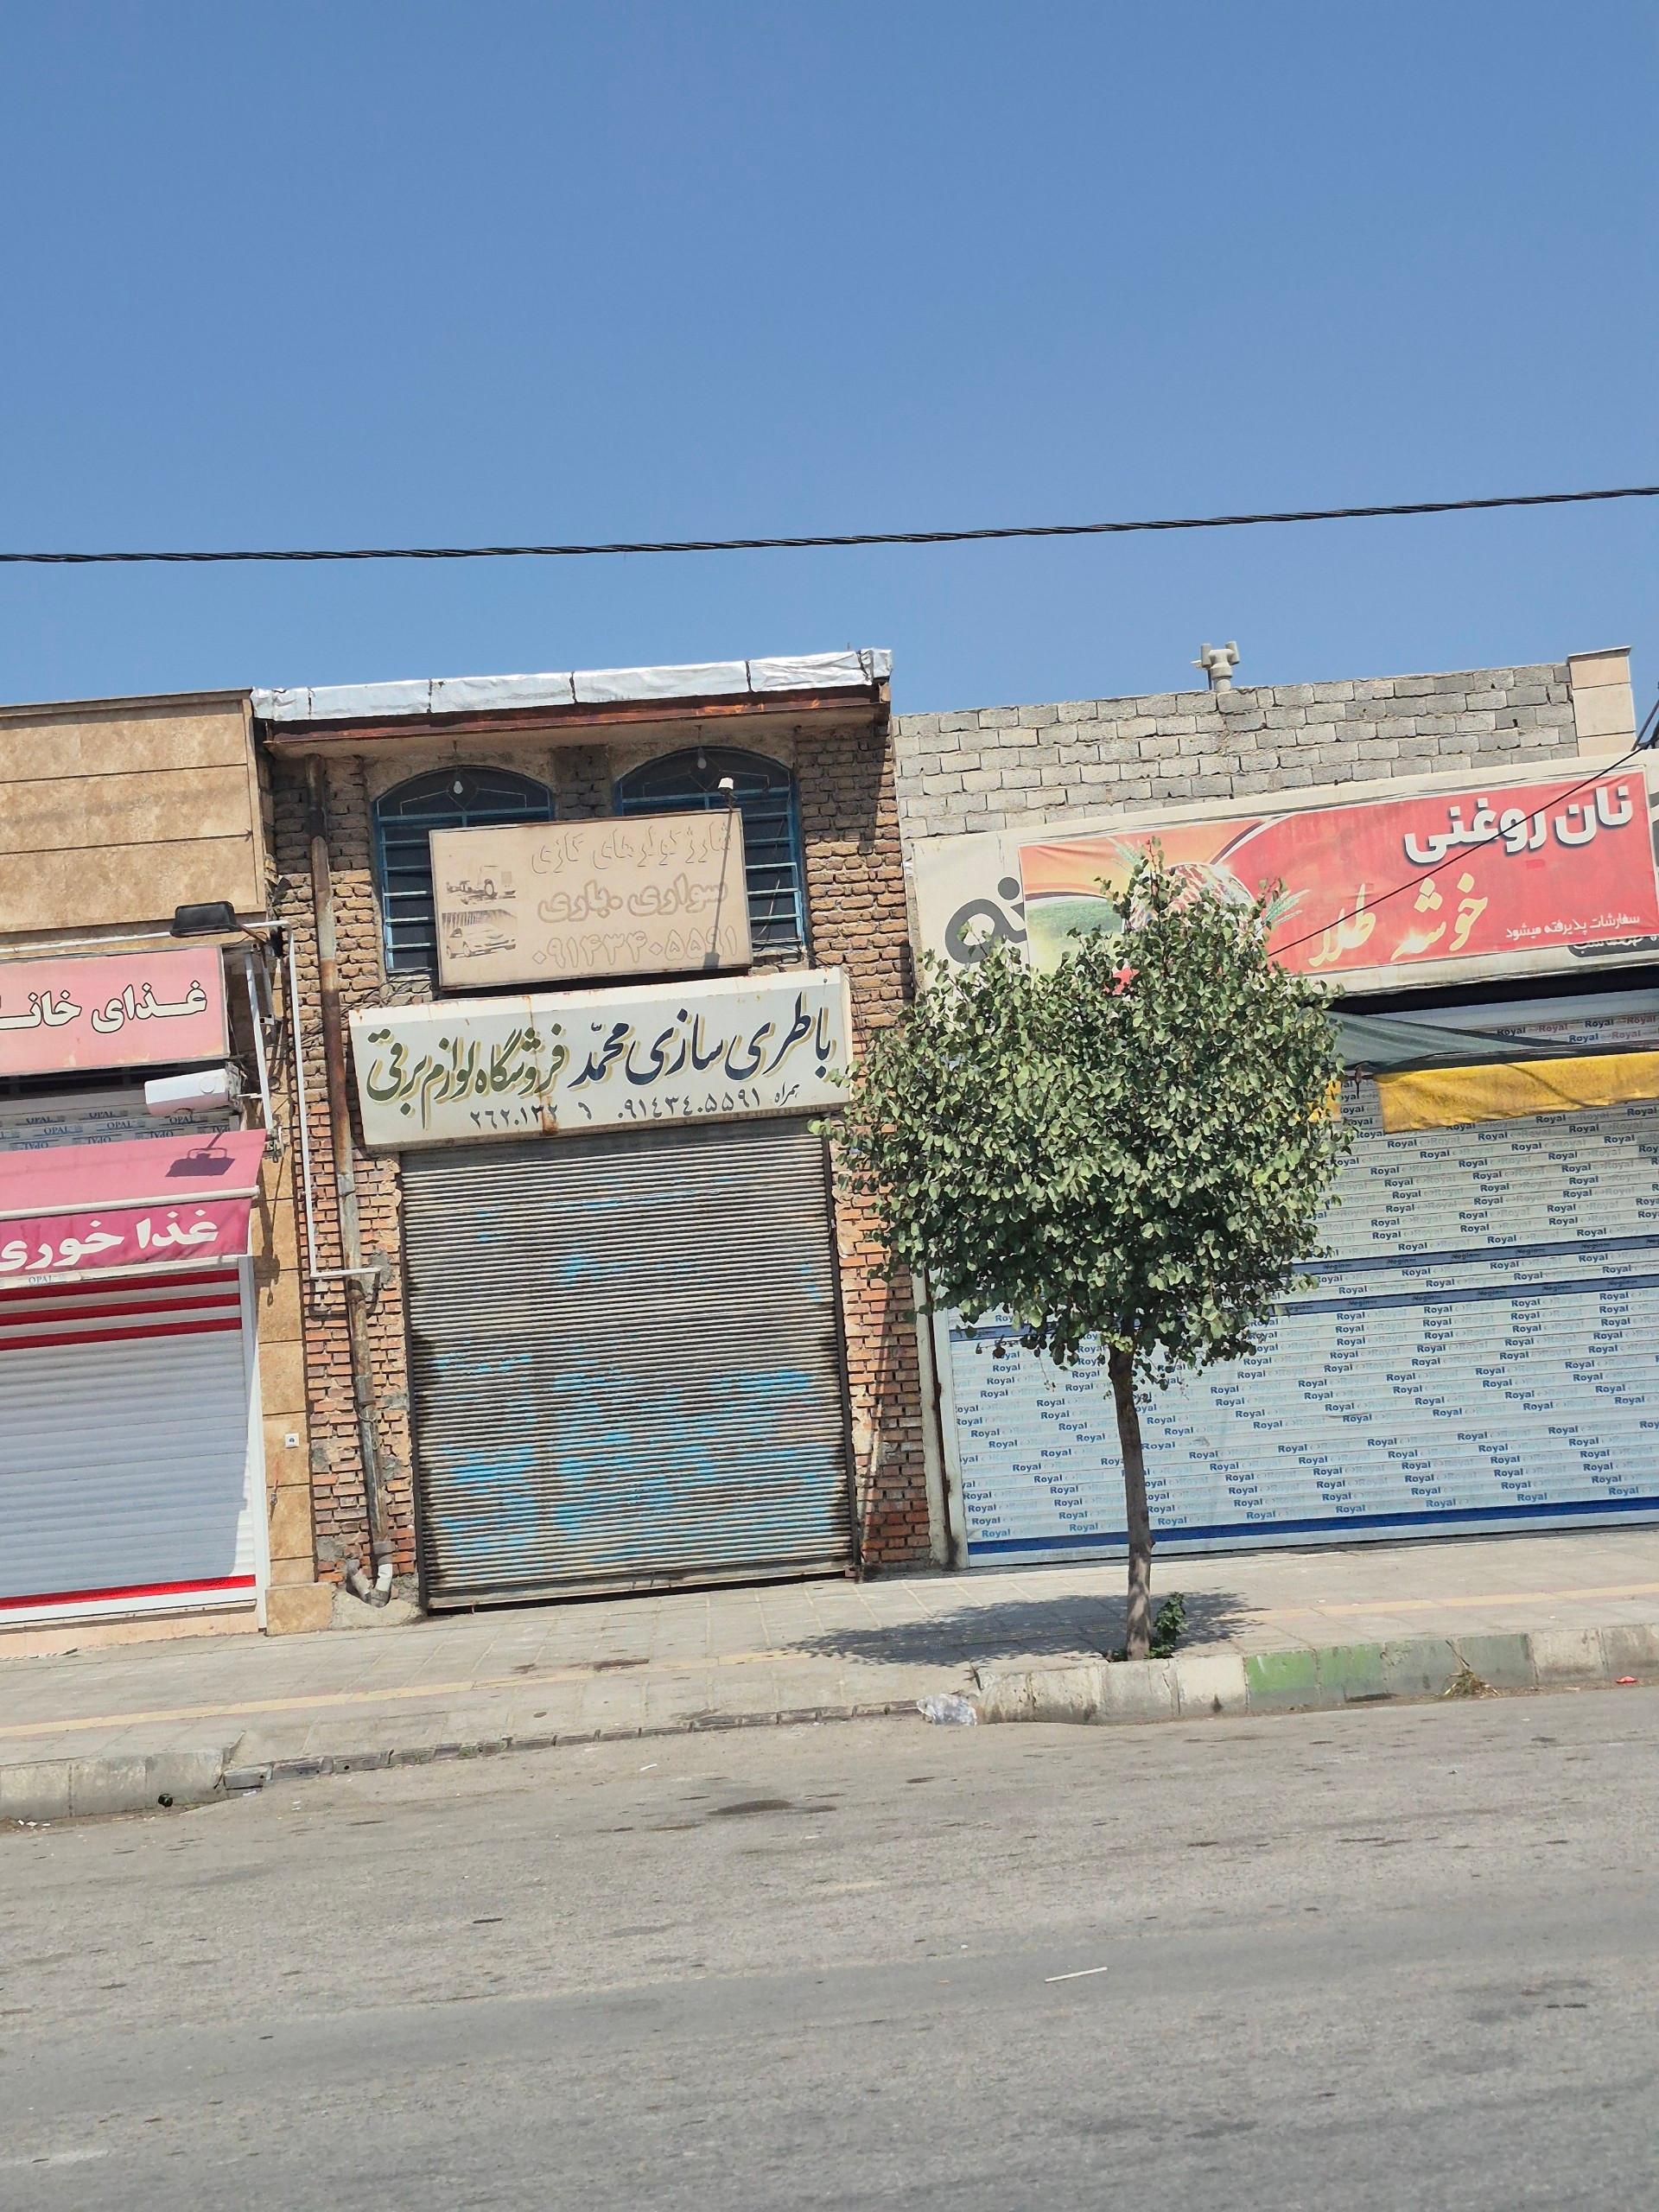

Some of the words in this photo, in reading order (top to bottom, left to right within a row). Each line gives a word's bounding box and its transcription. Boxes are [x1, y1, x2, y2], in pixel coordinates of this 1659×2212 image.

[1555, 784, 1634, 846] نان
[1403, 797, 1548, 864] روغنی
[537, 879, 611, 923] باری
[628, 873, 728, 918] سواری
[1308, 882, 1377, 967] طلا
[1390, 873, 1490, 962] خوشه
[1506, 923, 1542, 941] میشود
[1544, 918, 1587, 936] پذیرفته
[1590, 913, 1640, 929] سفارشات
[0, 989, 82, 1030] خان
[92, 980, 207, 1033] غذای
[724, 991, 834, 1081] باطری
[1585, 1018, 1614, 1028] Royal
[625, 1007, 725, 1086] سازی
[1569, 1033, 1599, 1043] Royal
[366, 1028, 432, 1116] برقی
[475, 1023, 568, 1096] فروشگاه
[421, 1036, 475, 1130] لوازم
[774, 1081, 801, 1107] همراه
[43, 1126, 69, 1135] OPAL
[106, 1121, 132, 1130] OPAL
[1535, 1115, 1566, 1123] Royal
[1627, 1107, 1657, 1117] Royal
[1389, 1139, 1417, 1149] Royal
[1570, 1124, 1599, 1135] Royal
[1510, 1142, 1541, 1151] Royal
[1604, 1135, 1634, 1144] Royal
[1371, 1166, 1400, 1177] Royal
[1459, 1159, 1488, 1169] Royal
[1548, 1151, 1578, 1161] Royal
[1384, 1178, 1414, 1188] Royal
[1560, 1163, 1592, 1173] Royal
[1481, 1183, 1510, 1193] Royal
[1570, 1175, 1599, 1185] Royal
[1386, 1204, 1415, 1214] Royal
[1475, 1196, 1503, 1206] Royal
[1564, 1189, 1592, 1199] Royal
[136, 1209, 219, 1249] غذا
[1372, 1218, 1400, 1229] Royal
[1459, 1211, 1488, 1221] Royal
[1373, 1230, 1402, 1241] Royal
[1550, 1217, 1578, 1227] Royal
[0, 1219, 125, 1272] خوری
[1487, 1235, 1516, 1244] Royal
[1576, 1227, 1606, 1237] Royal
[1338, 1285, 1367, 1294] Royal
[1427, 1279, 1455, 1289] Royal
[1604, 1265, 1631, 1275] Royal
[1402, 1268, 1430, 1277] Royal
[1490, 1261, 1518, 1270] Royal
[1578, 1253, 1608, 1263] Royal
[29, 1275, 54, 1285] OPAL
[1335, 1325, 1363, 1334] Royal
[1422, 1318, 1452, 1327] Royal
[1599, 1305, 1629, 1313] Royal
[1336, 1312, 1365, 1321] Royal
[1423, 1305, 1452, 1314] Royal
[1599, 1292, 1628, 1301] Royal
[1336, 1337, 1365, 1346] Royal
[1424, 1331, 1452, 1340] Royal
[1602, 1317, 1630, 1327] Royal
[1244, 1357, 1272, 1366] Royal
[1329, 1351, 1358, 1360] Royal
[1417, 1344, 1446, 1354] Royal
[1594, 1331, 1623, 1341] Royal
[1325, 1363, 1353, 1374] Royal
[1411, 1357, 1440, 1367] Royal
[1500, 1351, 1529, 1362] Royal
[1587, 1344, 1618, 1354] Royal
[986, 1376, 1014, 1385] Royal
[992, 1363, 1020, 1372] Royal
[1037, 1398, 1065, 1408] Royal
[1211, 1385, 1239, 1395] Royal
[1298, 1378, 1327, 1388] Royal
[1386, 1372, 1415, 1382] Royal
[1474, 1366, 1505, 1376] Royal
[1040, 1410, 1070, 1420] Royal
[1215, 1397, 1244, 1407] Royal
[1303, 1391, 1332, 1400] Royal
[1393, 1384, 1422, 1395] Royal
[1482, 1379, 1512, 1388] Royal
[1065, 1382, 1093, 1392] Royal
[969, 1428, 999, 1438] Royal
[1058, 1421, 1087, 1431] Royal
[1147, 1415, 1175, 1425] Royal
[1236, 1409, 1264, 1419] Royal
[1415, 1396, 1444, 1406] Royal
[1505, 1390, 1534, 1400] Royal
[989, 1440, 1017, 1449] Royal
[1075, 1433, 1104, 1442] Royal
[1165, 1427, 1193, 1436] Royal
[1343, 1414, 1372, 1424] Royal
[1432, 1408, 1462, 1417] Royal
[1614, 1395, 1644, 1405] Royal
[1012, 1462, 1041, 1472] Royal
[1189, 1450, 1217, 1459] Royal
[1367, 1438, 1397, 1446] Royal
[1548, 1426, 1579, 1434] Royal
[1041, 1448, 1071, 1459] Royal
[1298, 1455, 1327, 1465] Royal
[1388, 1450, 1417, 1459] Royal
[1478, 1443, 1508, 1452] Royal
[1568, 1437, 1599, 1446] Royal
[1313, 1466, 1342, 1476] Royal
[1491, 1455, 1519, 1465] Royal
[1580, 1449, 1610, 1459] Royal
[963, 1491, 992, 1500] Royal
[1049, 1484, 1078, 1495] Royal
[968, 1503, 995, 1513] Royal
[1054, 1498, 1082, 1507] Royal
[1228, 1485, 1257, 1495] Royal
[1404, 1474, 1434, 1483] Royal
[1494, 1468, 1522, 1478] Royal
[1034, 1474, 1062, 1484] Royal
[971, 1516, 1001, 1526] Royal
[1059, 1510, 1087, 1520] Royal
[1147, 1505, 1175, 1514] Royal
[1234, 1498, 1262, 1507] Royal
[1410, 1486, 1441, 1496] Royal
[1502, 1480, 1530, 1490] Royal
[1592, 1474, 1621, 1484] Royal
[981, 1528, 1010, 1538] Royal
[1069, 1522, 1098, 1532] Royal
[1247, 1510, 1275, 1520] Royal
[1336, 1504, 1364, 1514] Royal
[1516, 1492, 1548, 1502] Royal
[1608, 1486, 1639, 1496] Royal
